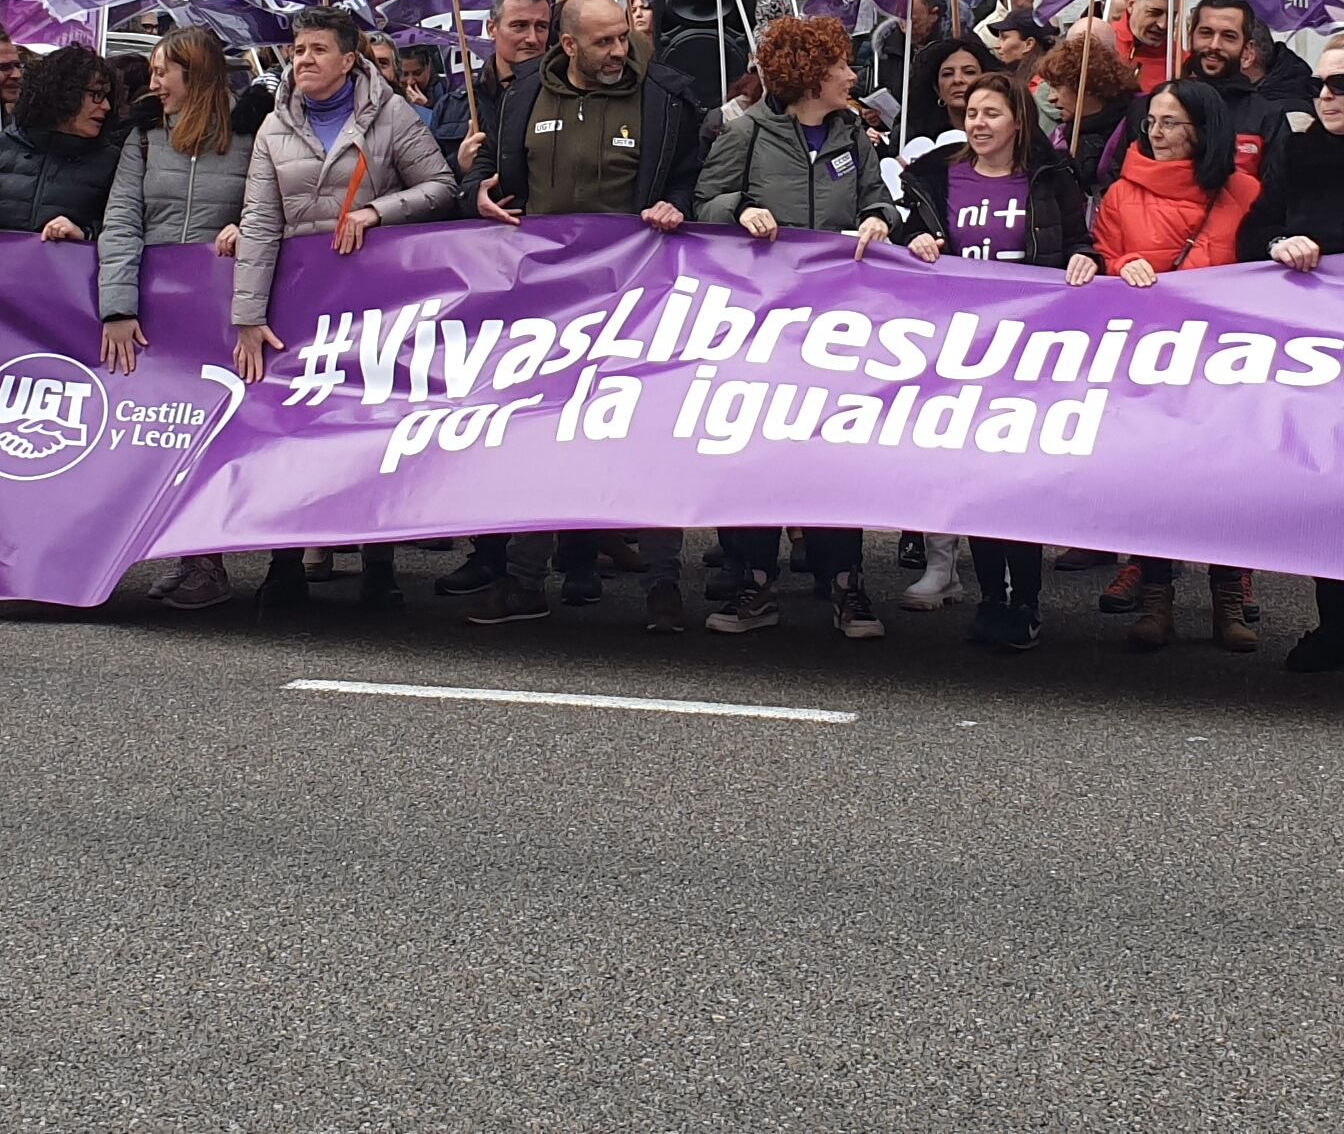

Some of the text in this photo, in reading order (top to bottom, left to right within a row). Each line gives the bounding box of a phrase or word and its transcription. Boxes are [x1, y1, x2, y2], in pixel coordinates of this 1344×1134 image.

[957, 198, 989, 228] ni
[962, 238, 991, 261] ni
[115, 400, 205, 426] Castilla
[380, 364, 1110, 474] por la igualdad
[110, 424, 192, 451] y León
